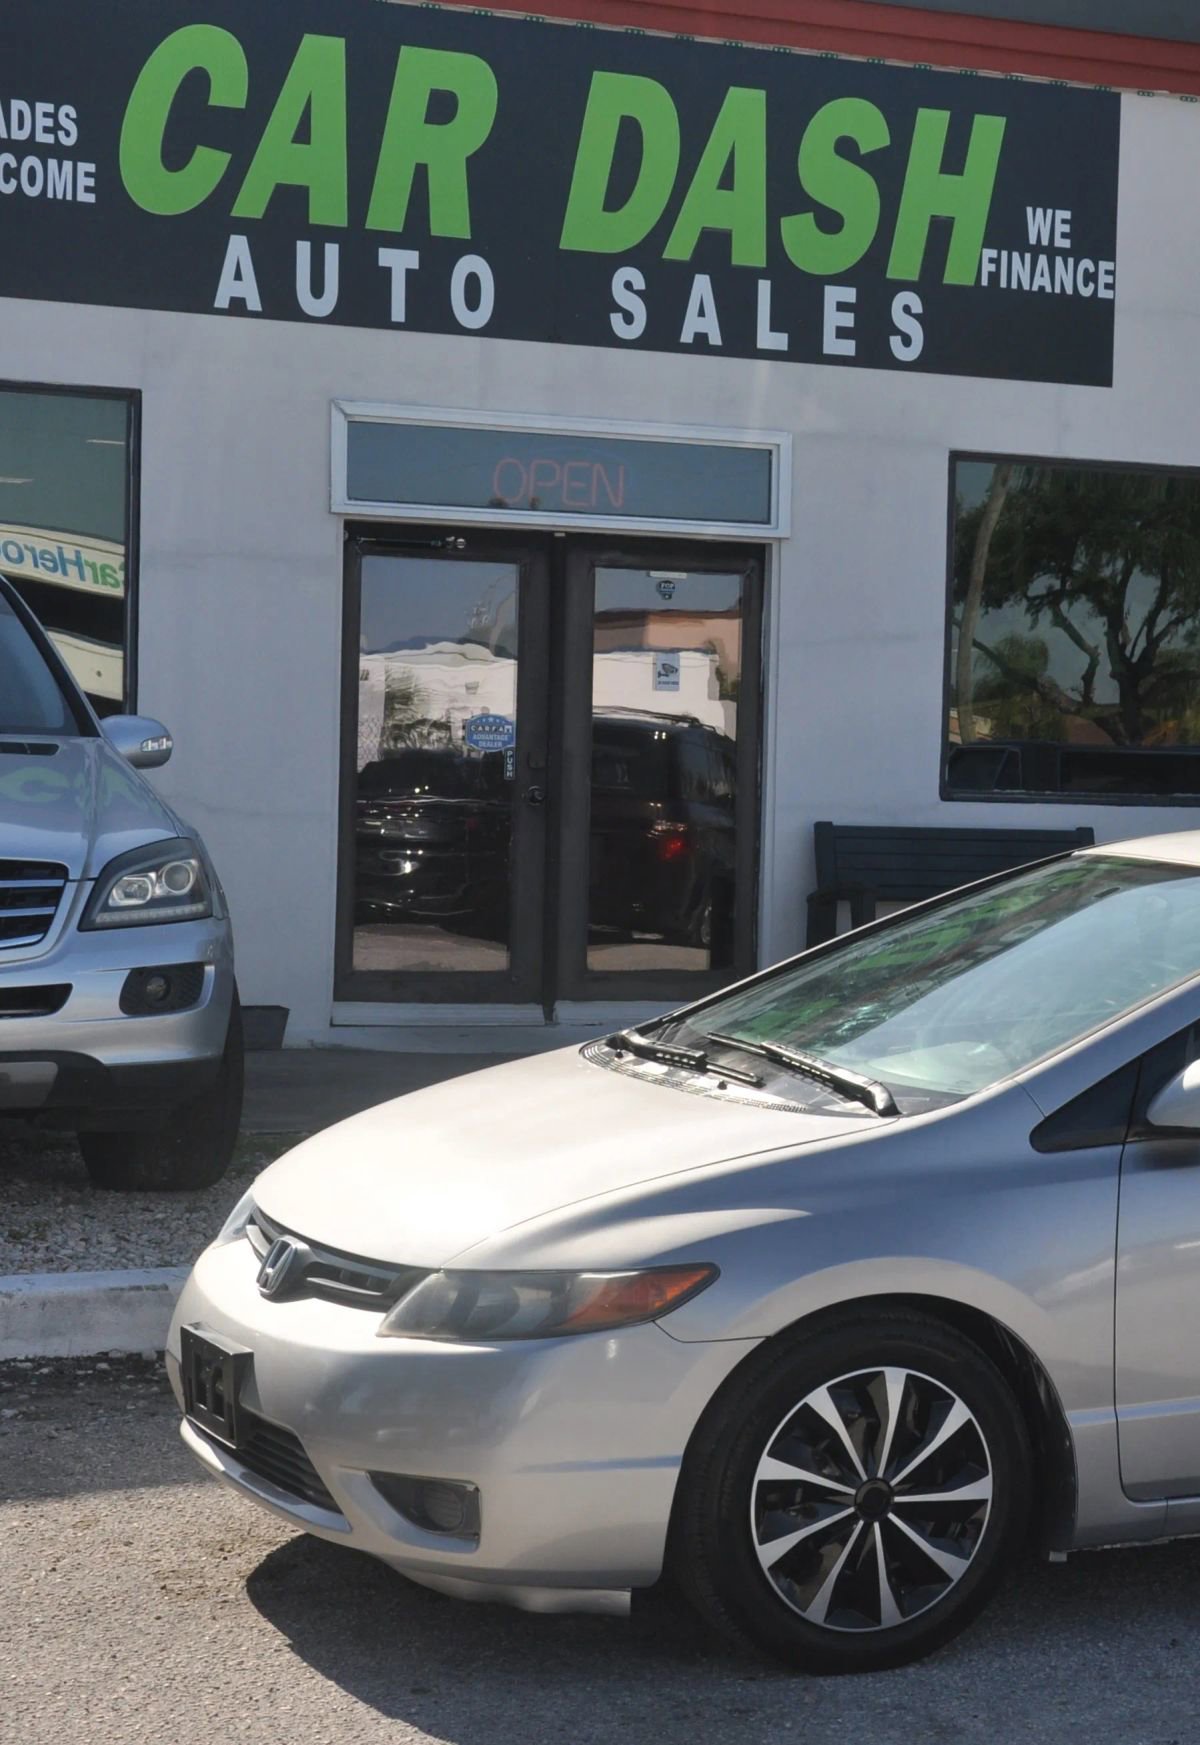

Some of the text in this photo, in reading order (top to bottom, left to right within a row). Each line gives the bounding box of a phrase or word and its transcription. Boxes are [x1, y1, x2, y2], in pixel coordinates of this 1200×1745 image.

[0, 152, 96, 203] COME
[120, 24, 1006, 286] CAR DASH
[1026, 206, 1072, 249] WE
[213, 234, 924, 362] AUTO SALES
[981, 248, 1115, 299] FINANCE
[492, 458, 625, 508] OPEN
